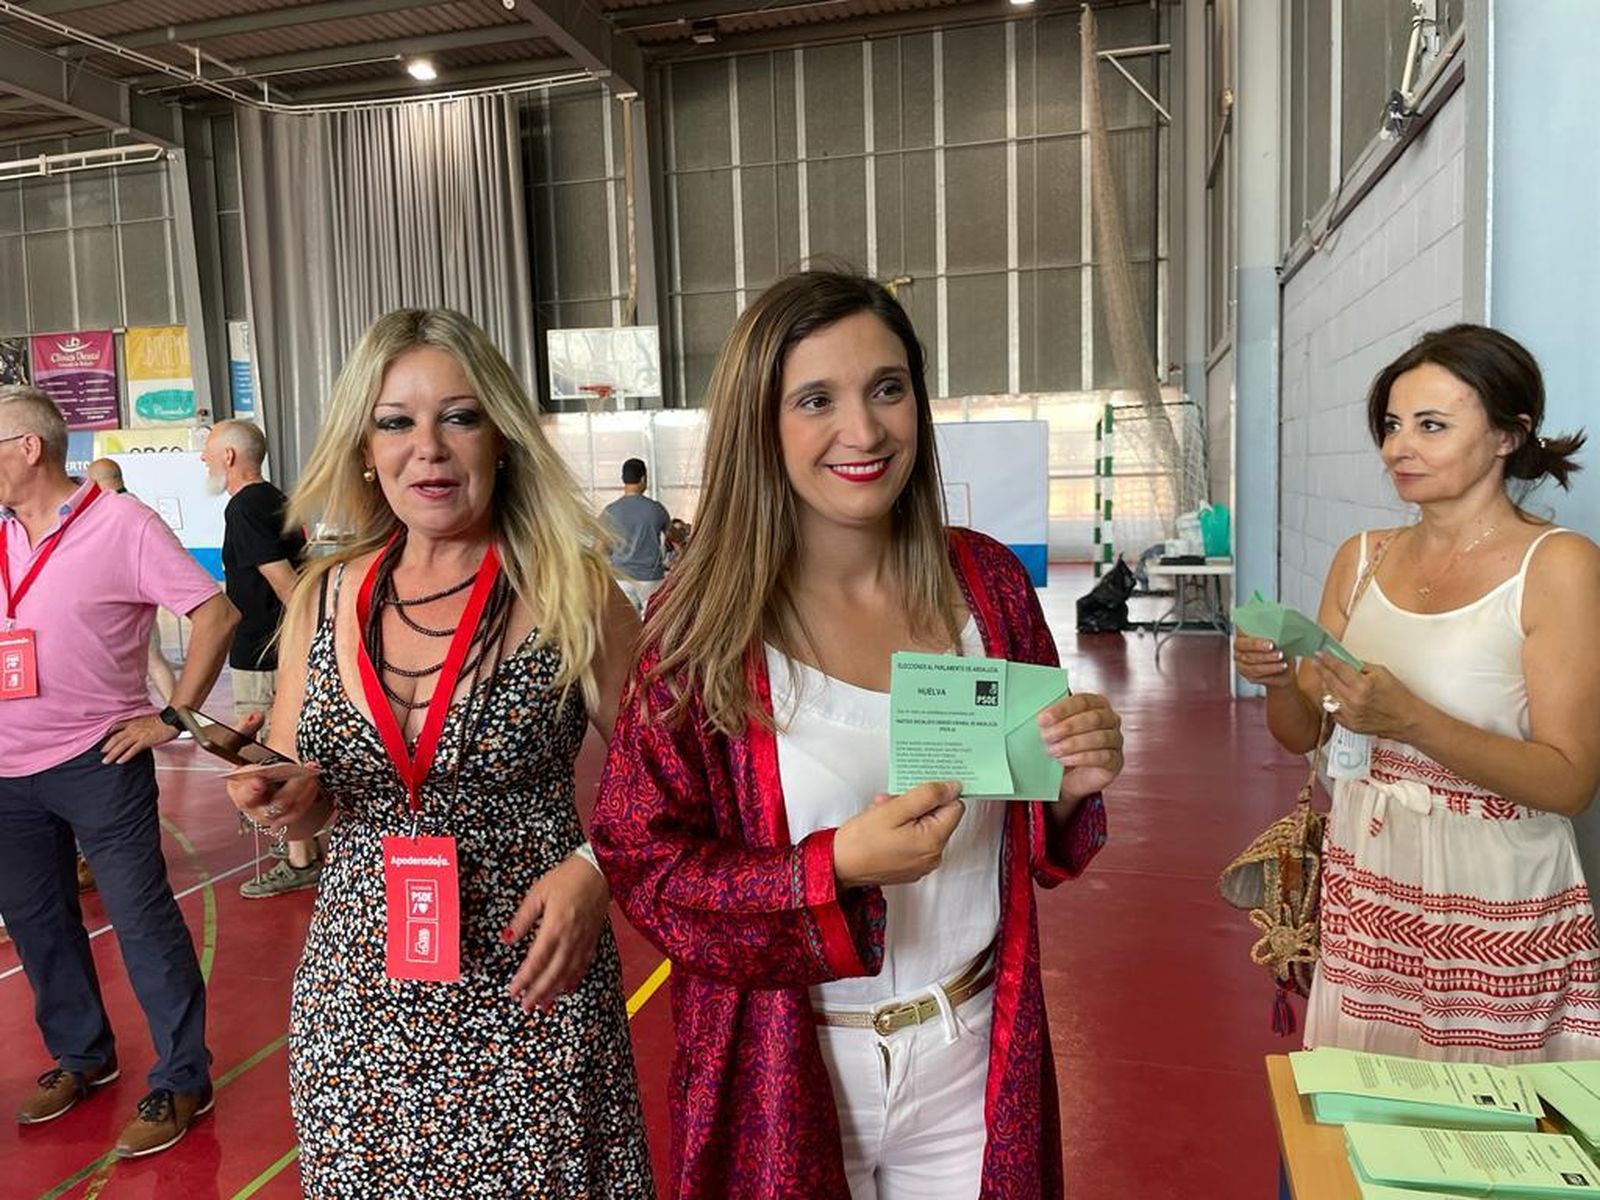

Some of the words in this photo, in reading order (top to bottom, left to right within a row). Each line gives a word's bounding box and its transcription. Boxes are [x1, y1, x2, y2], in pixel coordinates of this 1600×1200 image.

[917, 687, 947, 697] HUELVA
[976, 695, 999, 706] PSOE
[411, 891, 434, 903] PSOE
